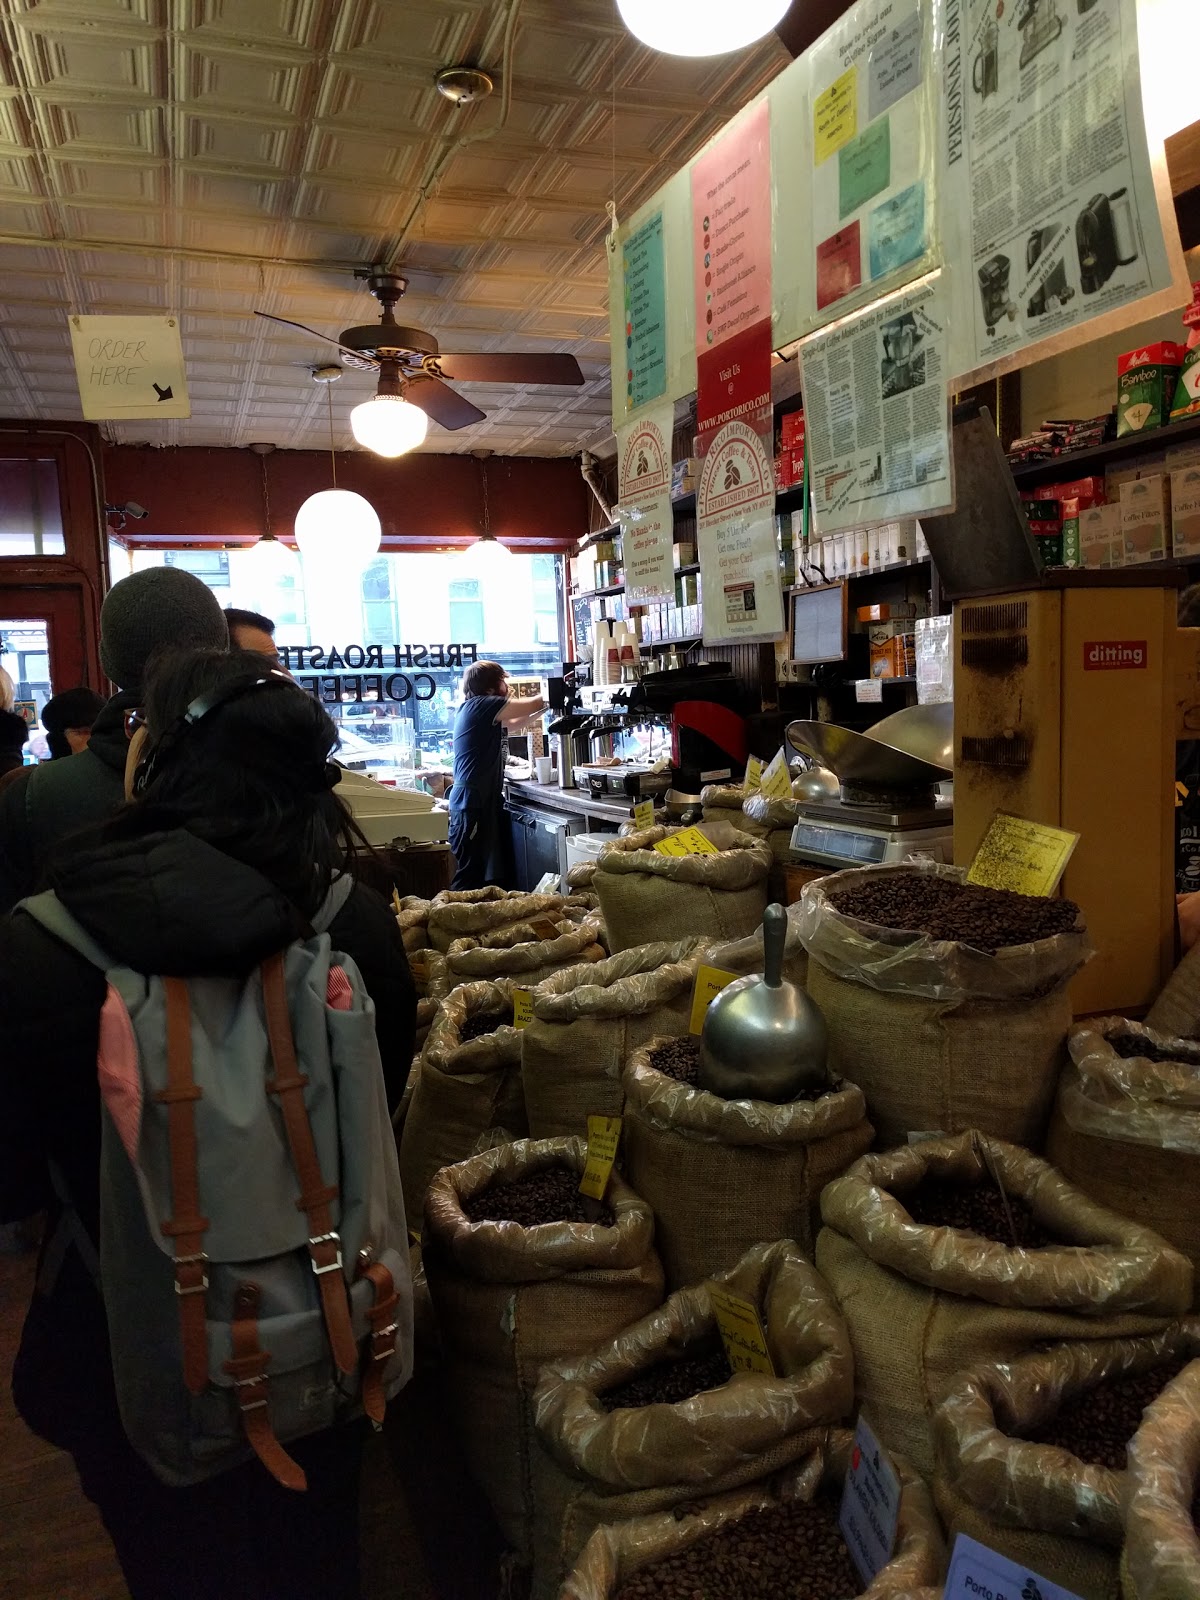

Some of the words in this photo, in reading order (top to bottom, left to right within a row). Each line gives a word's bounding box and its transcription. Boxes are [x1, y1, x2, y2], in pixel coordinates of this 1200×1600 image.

[840, 43, 853, 58] How
[880, 5, 893, 20] our
[947, 0, 961, 46] JOU
[867, 26, 886, 47] Signs
[948, 48, 962, 166] PERSONAL
[1041, 252, 1052, 267] Price
[1052, 235, 1066, 252] starts
[802, 343, 826, 361] Single-Cup
[826, 336, 841, 348] Coffee
[842, 326, 859, 342] Makers
[860, 316, 876, 332] Battle
[876, 312, 884, 324] for
[885, 304, 902, 318] Home
[89, 338, 149, 362] ORDER
[90, 366, 144, 385] HERE
[719, 368, 732, 382] Visit
[732, 364, 741, 376] Us
[1122, 370, 1157, 388] Bamboo
[728, 383, 734, 396] @
[698, 392, 770, 432] WWW.PORTORICO.COM
[628, 430, 639, 446] RICO
[639, 420, 665, 450] IMPORTING
[636, 439, 649, 452] Coffee
[700, 459, 711, 505] PORTO
[710, 432, 725, 458] RICO
[726, 424, 764, 458] IMPORTING
[709, 463, 723, 494] Finest
[722, 444, 740, 460] Coffee
[741, 448, 746, 457] &
[748, 453, 757, 478] Teas
[626, 479, 652, 494] ESTABLISHED
[708, 489, 746, 512] ESTABLISHED
[748, 485, 759, 498] 1907
[734, 509, 742, 518] New
[742, 506, 752, 516] York
[752, 503, 758, 511] NY
[1123, 514, 1141, 523] Coffee
[1142, 511, 1160, 520] Filters
[1175, 504, 1194, 513] Coffee
[630, 529, 637, 538] No
[637, 526, 649, 537] Hands
[717, 529, 726, 540] Buy
[727, 529, 730, 538] 5
[634, 540, 645, 550] coffee
[718, 543, 726, 553] Get
[727, 543, 735, 551] one
[719, 558, 728, 568] Get
[728, 557, 740, 568] your
[741, 553, 753, 563] Card
[1089, 645, 1143, 664] ditting
[965, 1576, 993, 1600] Porto
